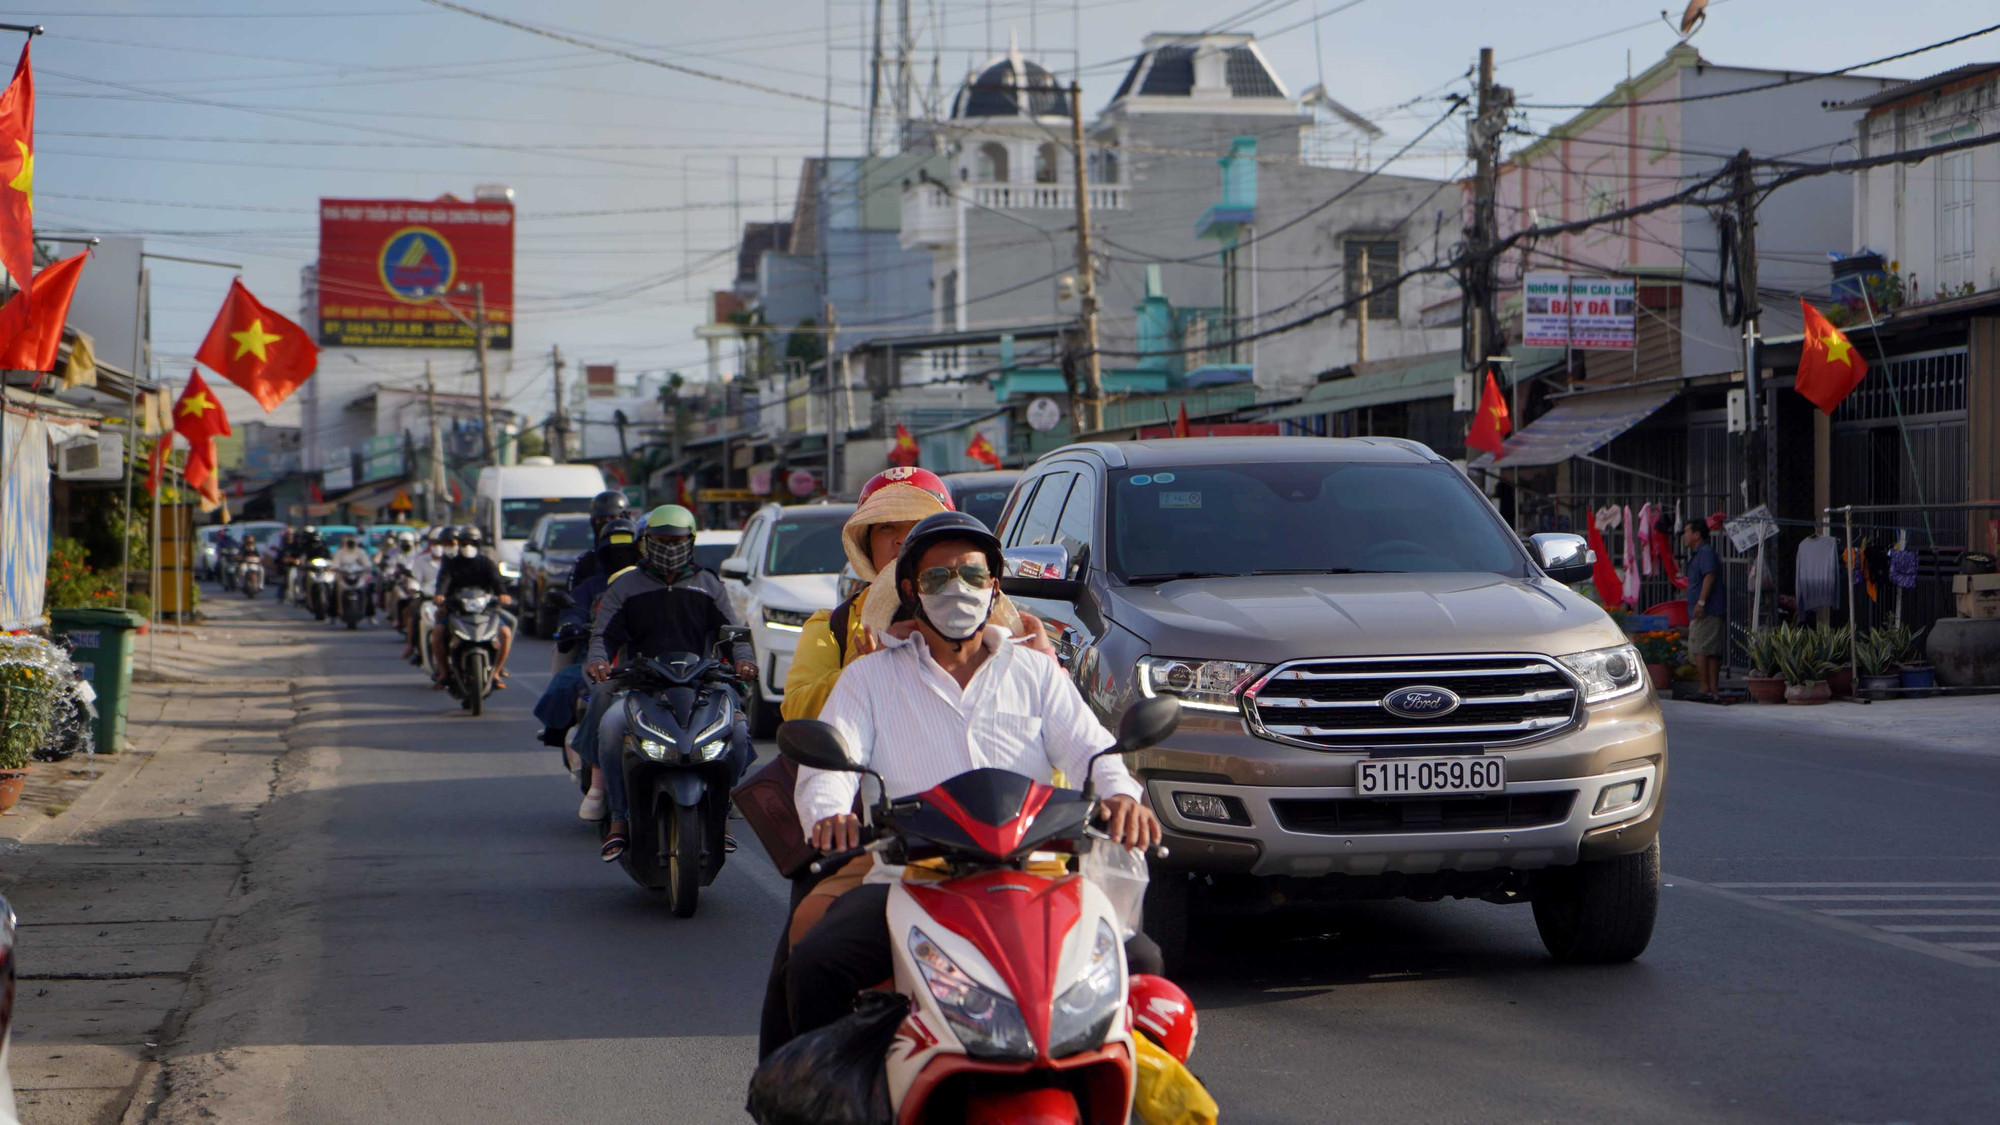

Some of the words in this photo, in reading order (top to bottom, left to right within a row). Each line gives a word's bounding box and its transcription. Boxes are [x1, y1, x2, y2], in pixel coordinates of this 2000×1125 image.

[1527, 282, 1558, 294] NHÔM
[1562, 284, 1588, 295] KNH
[1591, 284, 1611, 295] CAO
[1403, 693, 1441, 709] Ford
[1362, 760, 1500, 792] 51H-059.60
